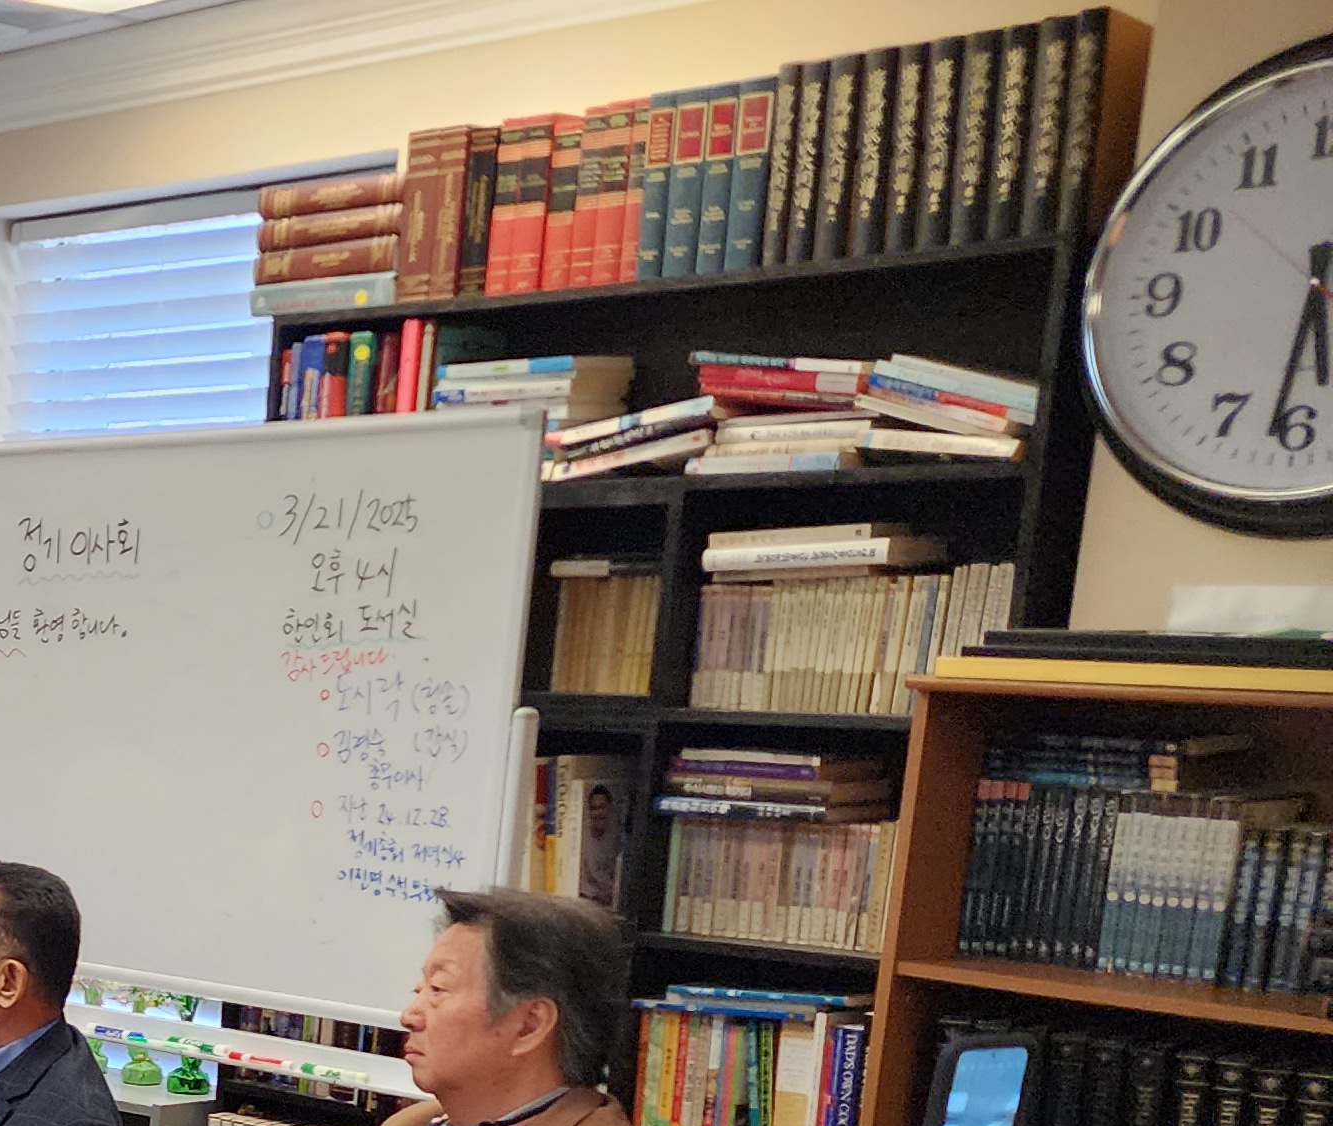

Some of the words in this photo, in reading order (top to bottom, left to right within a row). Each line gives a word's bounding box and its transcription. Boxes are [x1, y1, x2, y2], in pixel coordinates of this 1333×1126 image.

[1235, 143, 1279, 191] 11
[1175, 206, 1223, 254] 10
[1145, 272, 1184, 318] 9
[1155, 341, 1197, 387] 8
[1212, 391, 1252, 438] 7
[1278, 405, 1317, 452] 6
[279, 489, 418, 545] 3/21/2025
[311, 549, 345, 594] 오후
[356, 547, 398, 597] 4시
[282, 607, 343, 644] 한인회
[357, 600, 421, 640] 도서실
